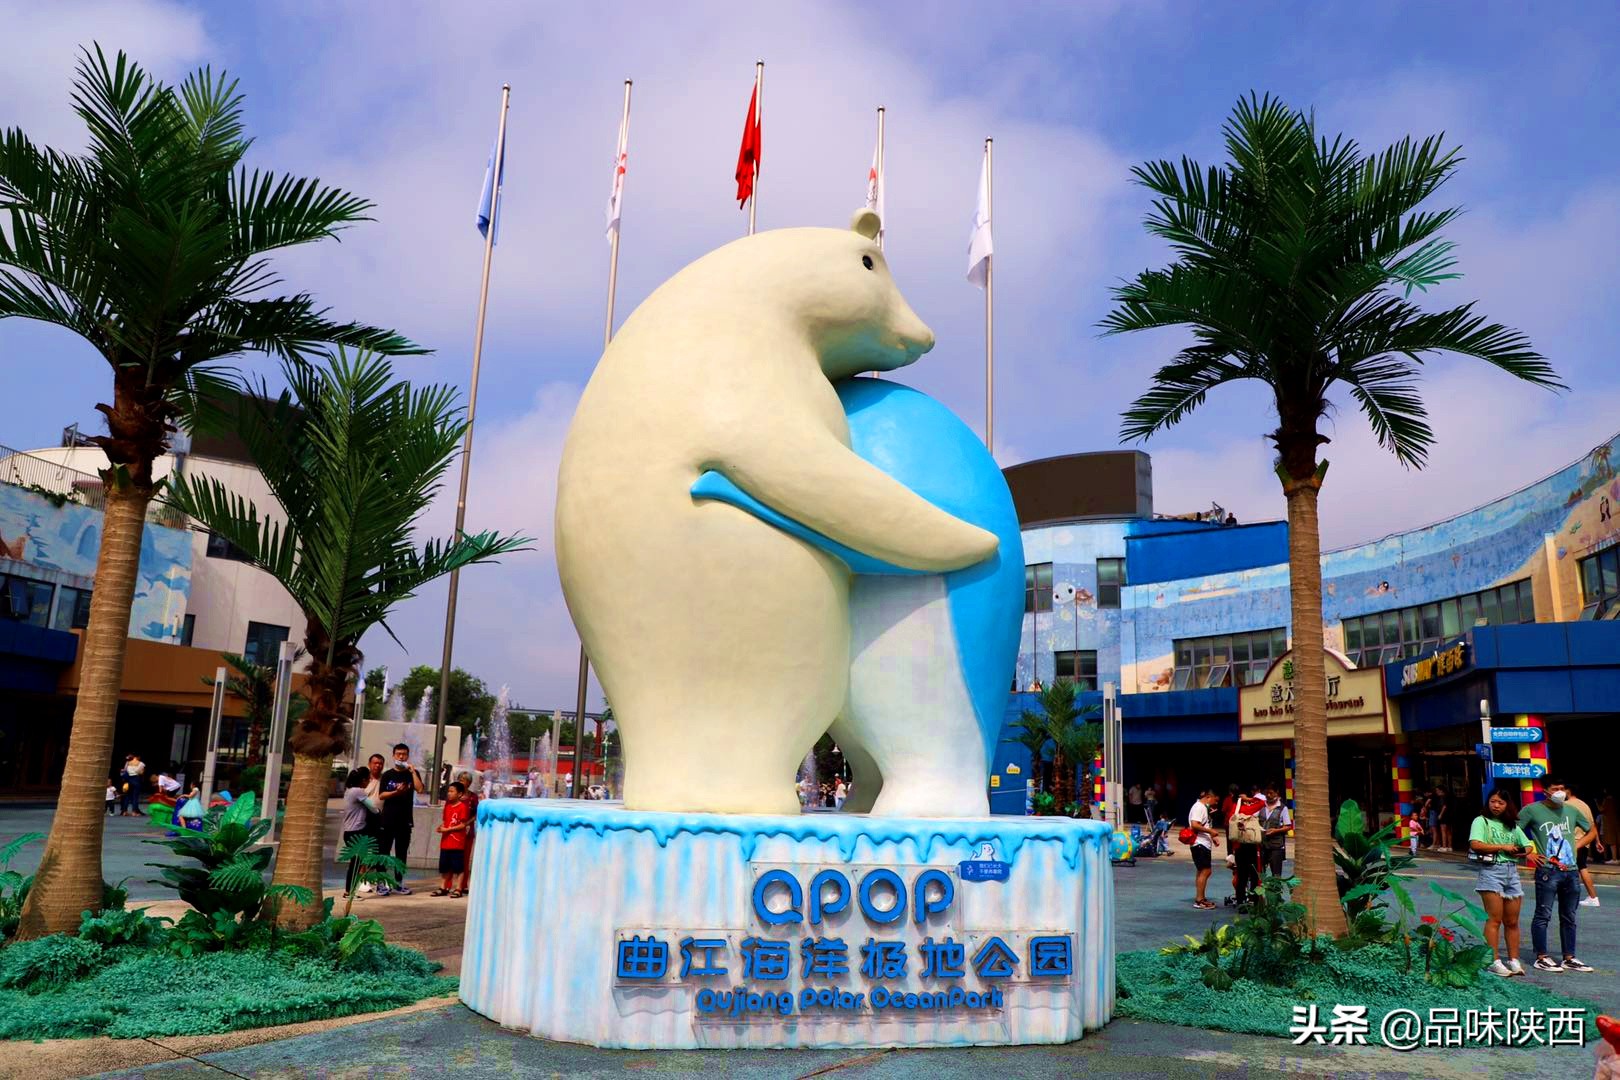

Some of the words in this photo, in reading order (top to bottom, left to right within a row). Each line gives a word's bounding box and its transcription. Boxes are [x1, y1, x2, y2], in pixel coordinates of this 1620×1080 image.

[752, 868, 955, 925] QPOP
[616, 935, 1073, 981] 曲江海洋极地公园
[696, 986, 794, 1016] Qujiang
